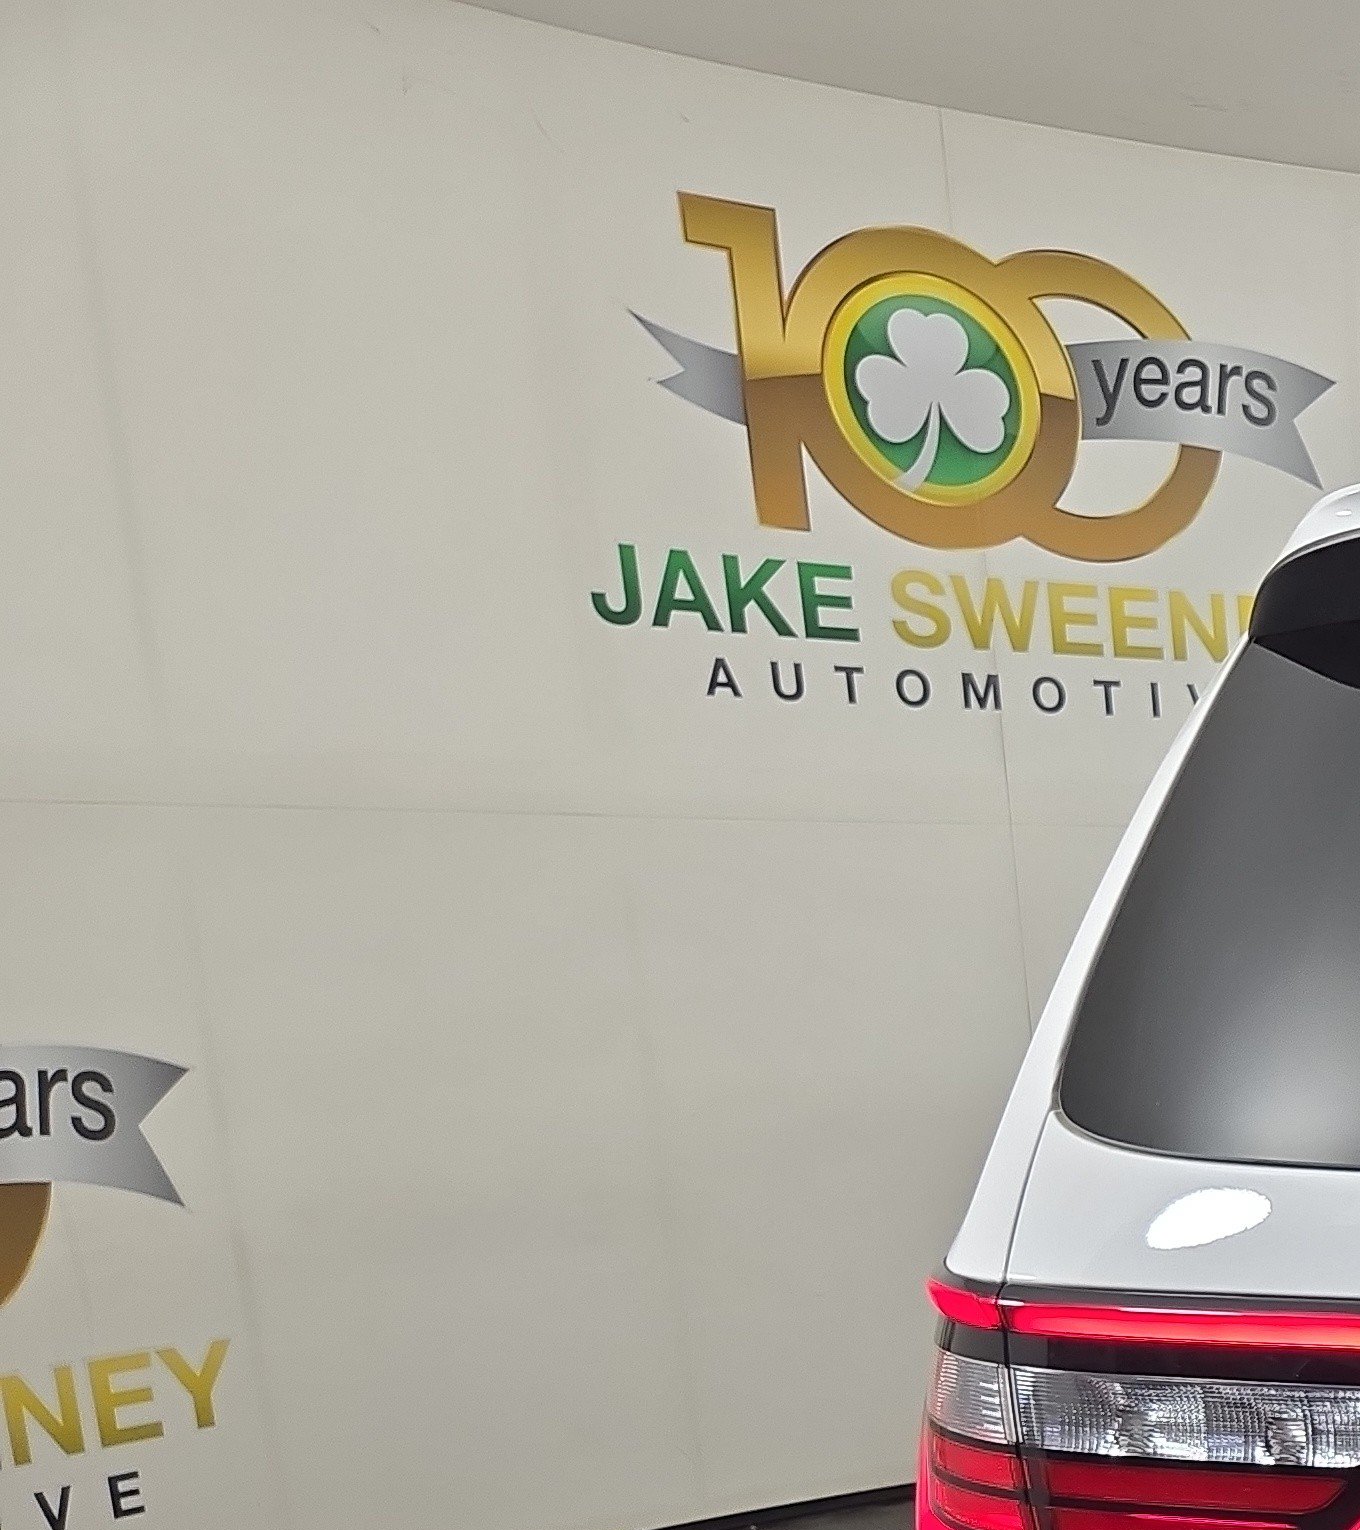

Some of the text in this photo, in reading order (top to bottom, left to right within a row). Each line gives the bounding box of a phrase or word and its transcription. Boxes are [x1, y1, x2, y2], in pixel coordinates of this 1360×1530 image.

[1091, 353, 1276, 427] years
[591, 542, 1256, 663] JAKE SWEEN
